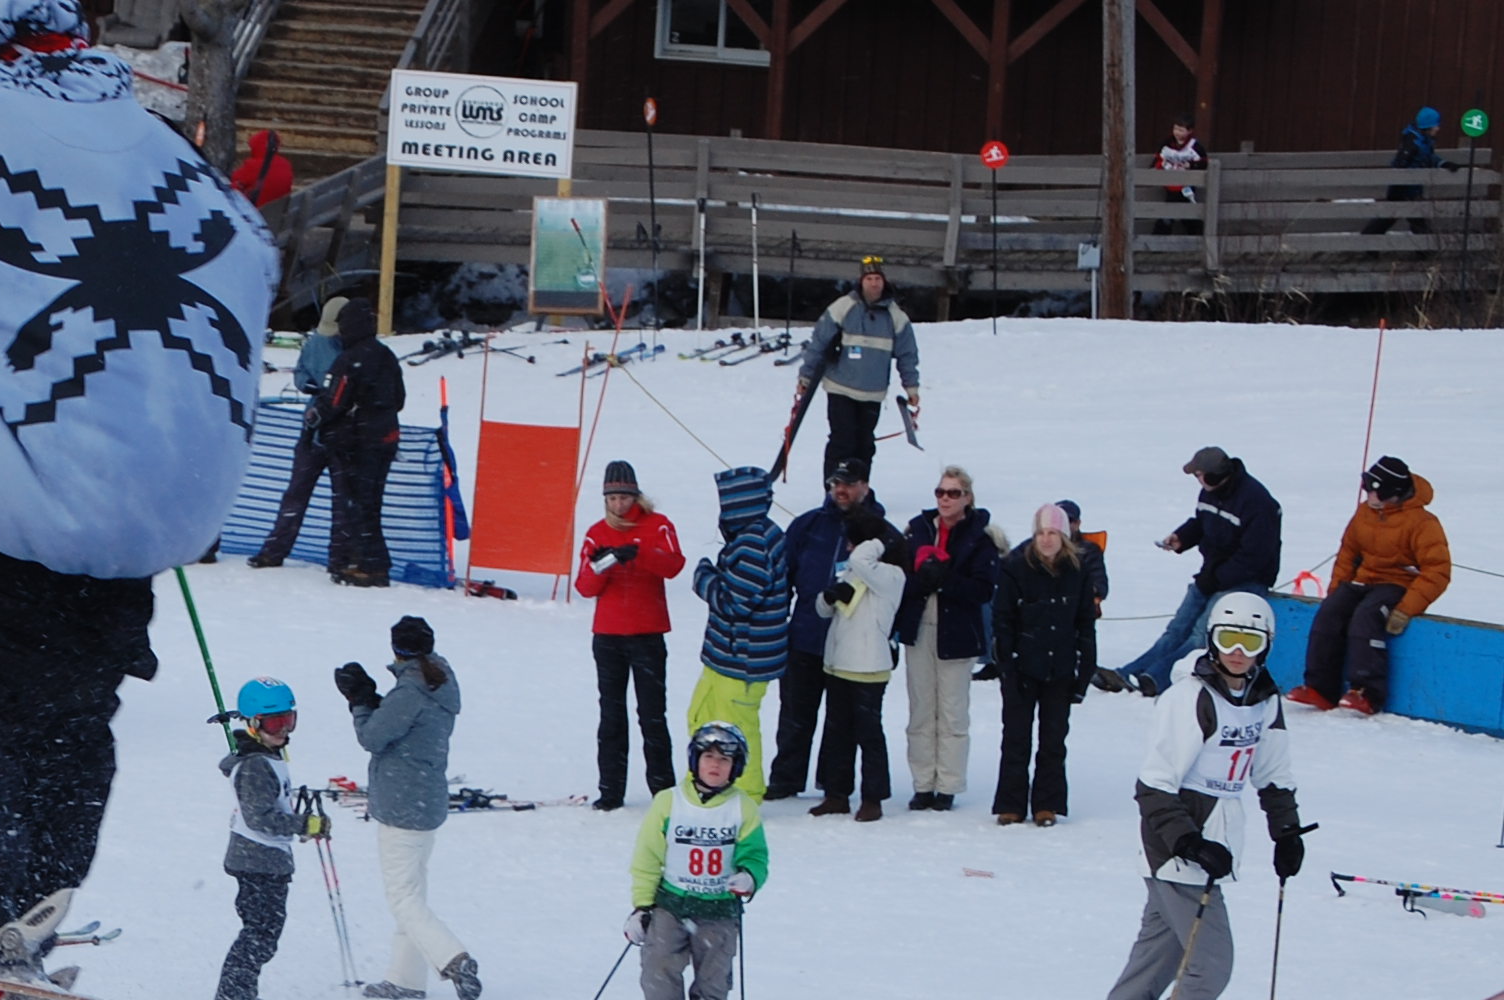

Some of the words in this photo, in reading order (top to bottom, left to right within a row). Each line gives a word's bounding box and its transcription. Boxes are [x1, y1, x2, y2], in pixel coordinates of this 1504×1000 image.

[405, 85, 450, 99] GROUP
[513, 94, 565, 108] SCHOOL
[400, 103, 451, 117] PRIVATE
[404, 119, 446, 131] LESSONS
[518, 112, 557, 125] CAMP
[506, 127, 567, 141] PROGRAMS
[401, 141, 495, 162] MEETING
[502, 149, 557, 167] AREA
[689, 848, 722, 876] 88
